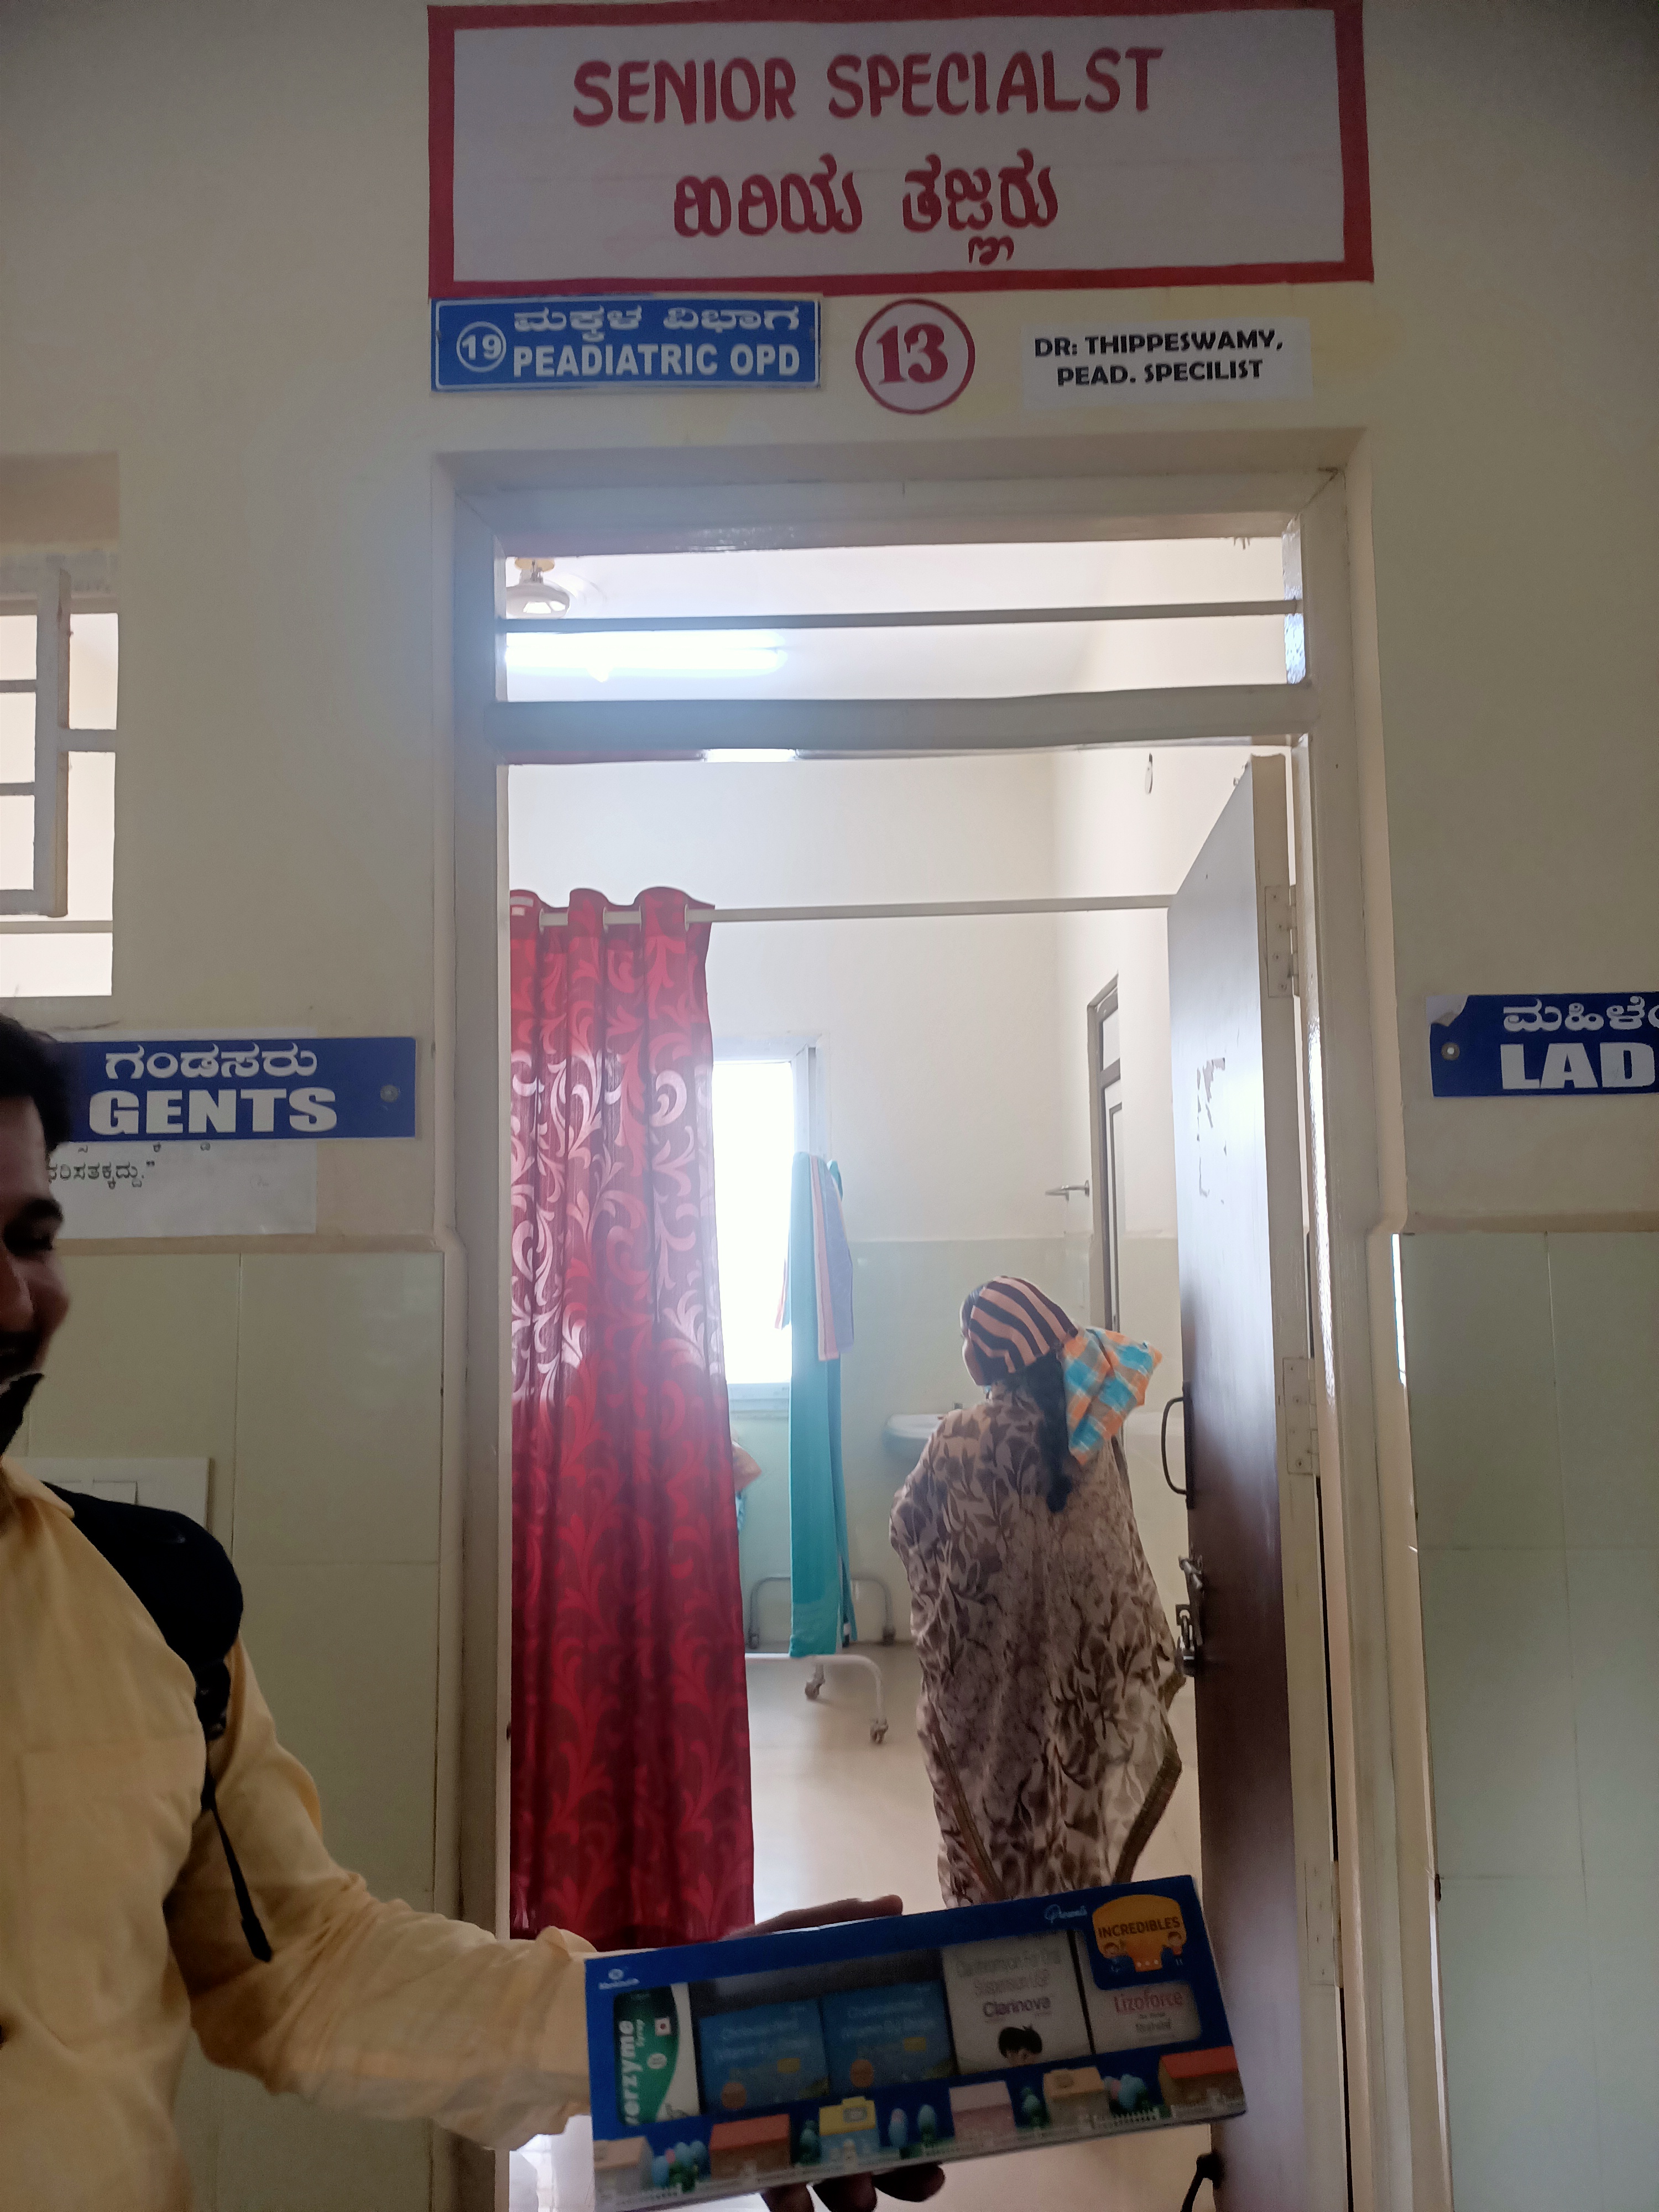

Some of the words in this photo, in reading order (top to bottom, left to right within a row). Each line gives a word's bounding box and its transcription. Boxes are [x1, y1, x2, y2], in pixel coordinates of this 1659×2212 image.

[573, 58, 796, 127] SENIOR
[827, 47, 1164, 119] SPECIALST
[514, 305, 643, 343] ಮಕ್ಕಳ
[662, 305, 800, 333] ವಿಭಾಗ
[461, 334, 500, 361] 19
[513, 343, 718, 377] PEADIATRIC
[730, 343, 800, 376] OPD
[876, 322, 948, 385] 13
[1035, 336, 1078, 357] DR:
[1084, 329, 1283, 355] THIPPESWAMY,
[1057, 365, 1136, 387] PEAD.
[1144, 359, 1263, 383] SPECILIST
[105, 1042, 317, 1079] ಗಂಡಸರು
[89, 1087, 337, 1135] GENTS
[1098, 1916, 1181, 1938] INCREDIBLES
